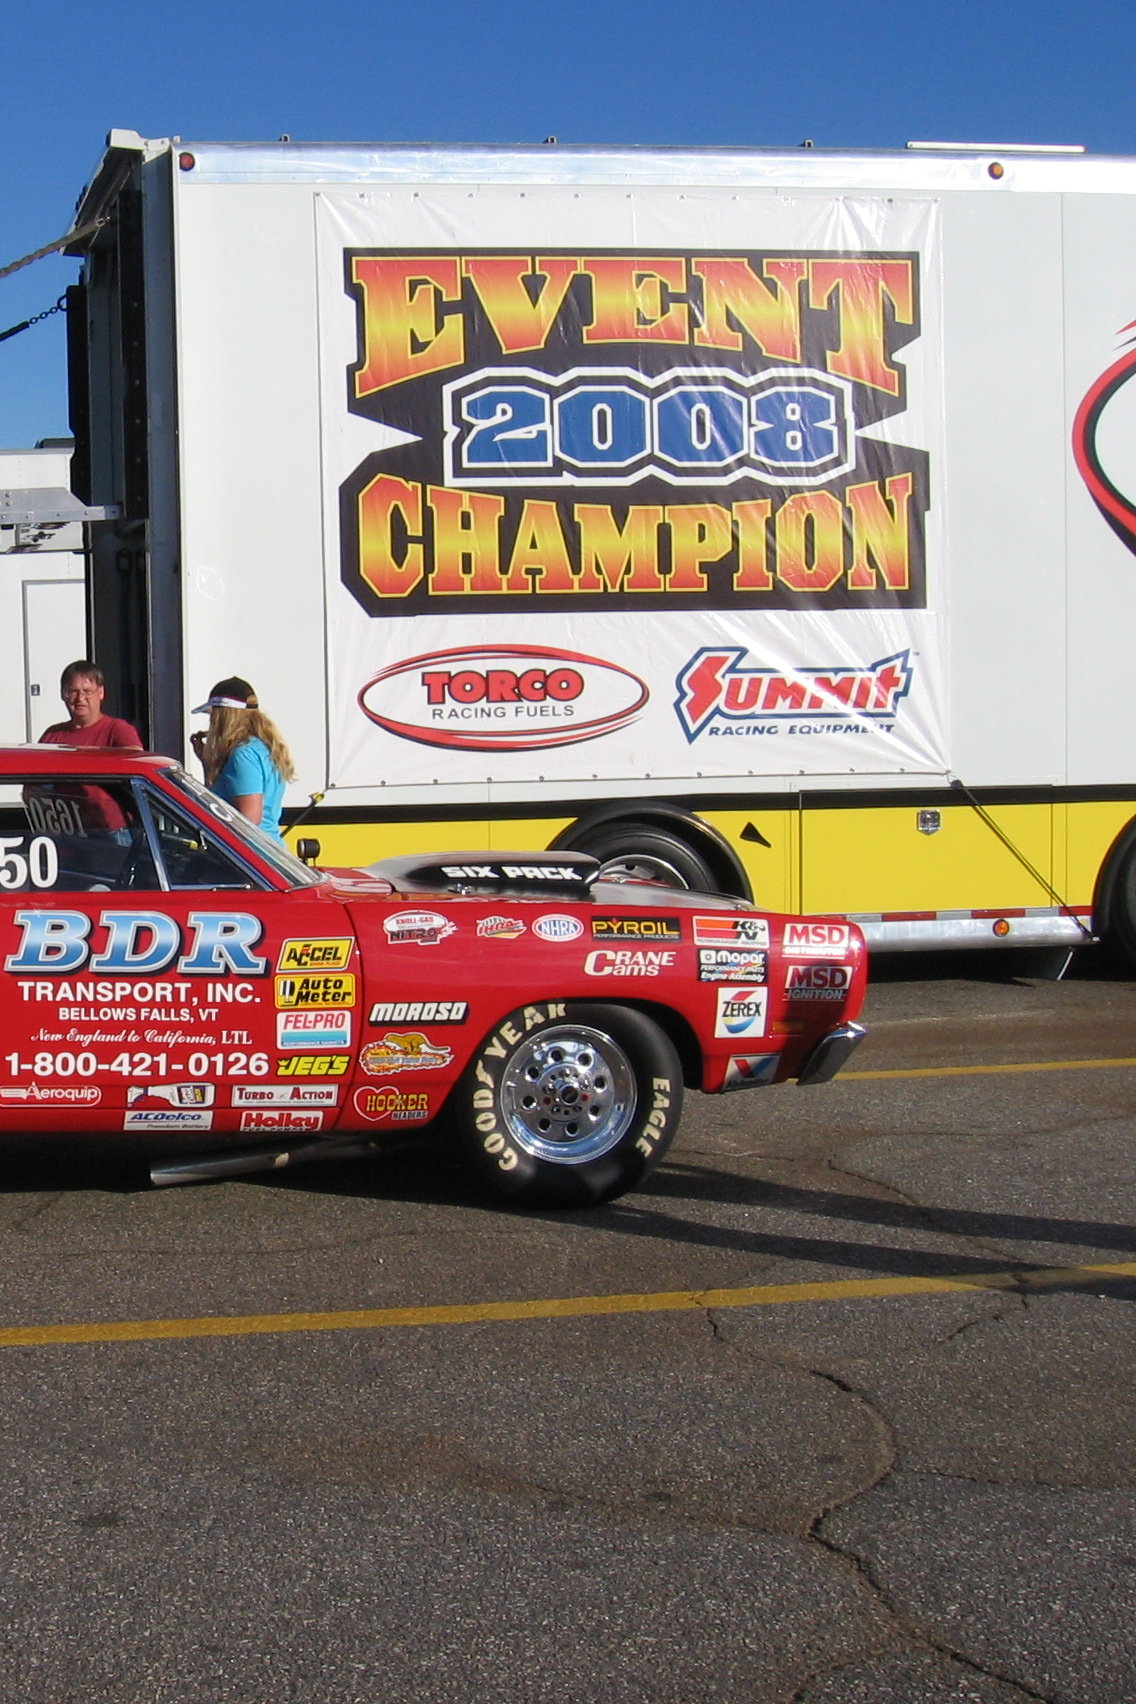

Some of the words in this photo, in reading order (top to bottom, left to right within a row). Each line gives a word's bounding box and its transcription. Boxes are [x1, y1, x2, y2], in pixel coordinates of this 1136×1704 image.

[352, 256, 915, 398] EVENT
[461, 384, 840, 470] 2008
[357, 474, 912, 599] CHAMPION
[422, 668, 585, 705] TORCO
[432, 706, 508, 720] RACING
[513, 704, 576, 719] FUELS
[708, 725, 780, 738] RACING
[441, 866, 500, 878] SIX
[501, 866, 583, 880] PACK
[539, 919, 575, 937] NHRA
[592, 920, 680, 935] PYROIL
[788, 925, 845, 945] MSD
[4, 909, 267, 975] BDR
[285, 944, 342, 966] ACCEL
[584, 950, 676, 973] CRANE
[717, 951, 765, 967] Mopar
[299, 977, 343, 990] Auto
[789, 967, 848, 989] MSD
[17, 981, 199, 1006] TRANSPORT,
[207, 982, 262, 1004] INC.
[296, 990, 352, 1004] Meter
[787, 989, 845, 1000] IGNITION
[58, 1007, 137, 1021] BELLOWS
[140, 1008, 195, 1023] FALLS,
[199, 1008, 219, 1021] VT
[369, 1002, 468, 1023] MOROSO
[722, 1001, 762, 1018] ZEREX
[284, 1012, 346, 1030] FEL-PRO
[30, 1028, 64, 1042] New
[65, 1028, 127, 1048] England
[127, 1028, 141, 1043] to
[143, 1029, 217, 1048] California,
[221, 1030, 253, 1045] LTL
[5, 1052, 269, 1077] 1-800-421-0126
[276, 1055, 351, 1076] JEG'S
[26, 1081, 99, 1102] Aeroquip
[236, 1086, 275, 1101] TURBO
[289, 1086, 334, 1101] ACTION
[366, 1093, 429, 1112] HOOKER
[130, 1112, 202, 1121] ACDelco
[243, 1111, 321, 1131] Holley
[635, 1076, 671, 1158] EAGLE
